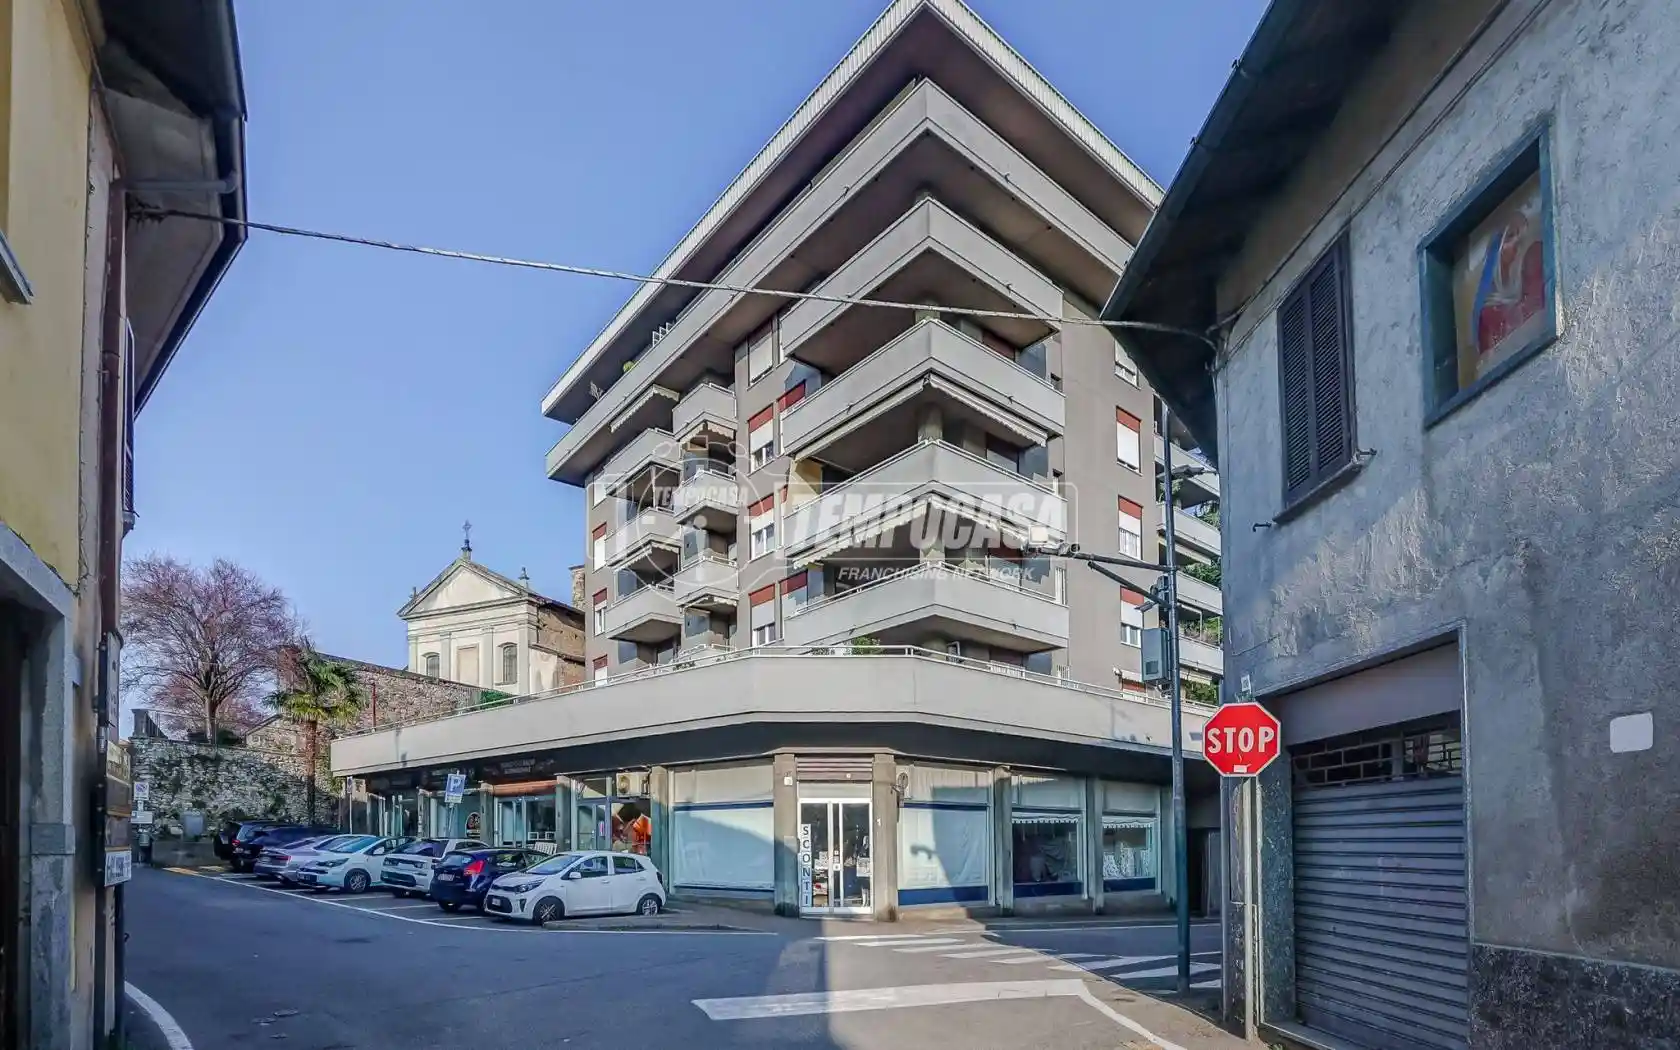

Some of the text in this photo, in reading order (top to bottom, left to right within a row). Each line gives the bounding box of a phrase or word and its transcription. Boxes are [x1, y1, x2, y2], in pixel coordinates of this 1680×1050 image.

[1207, 726, 1275, 754] STOP
[450, 776, 461, 792] P
[802, 826, 811, 905] SCONTI
